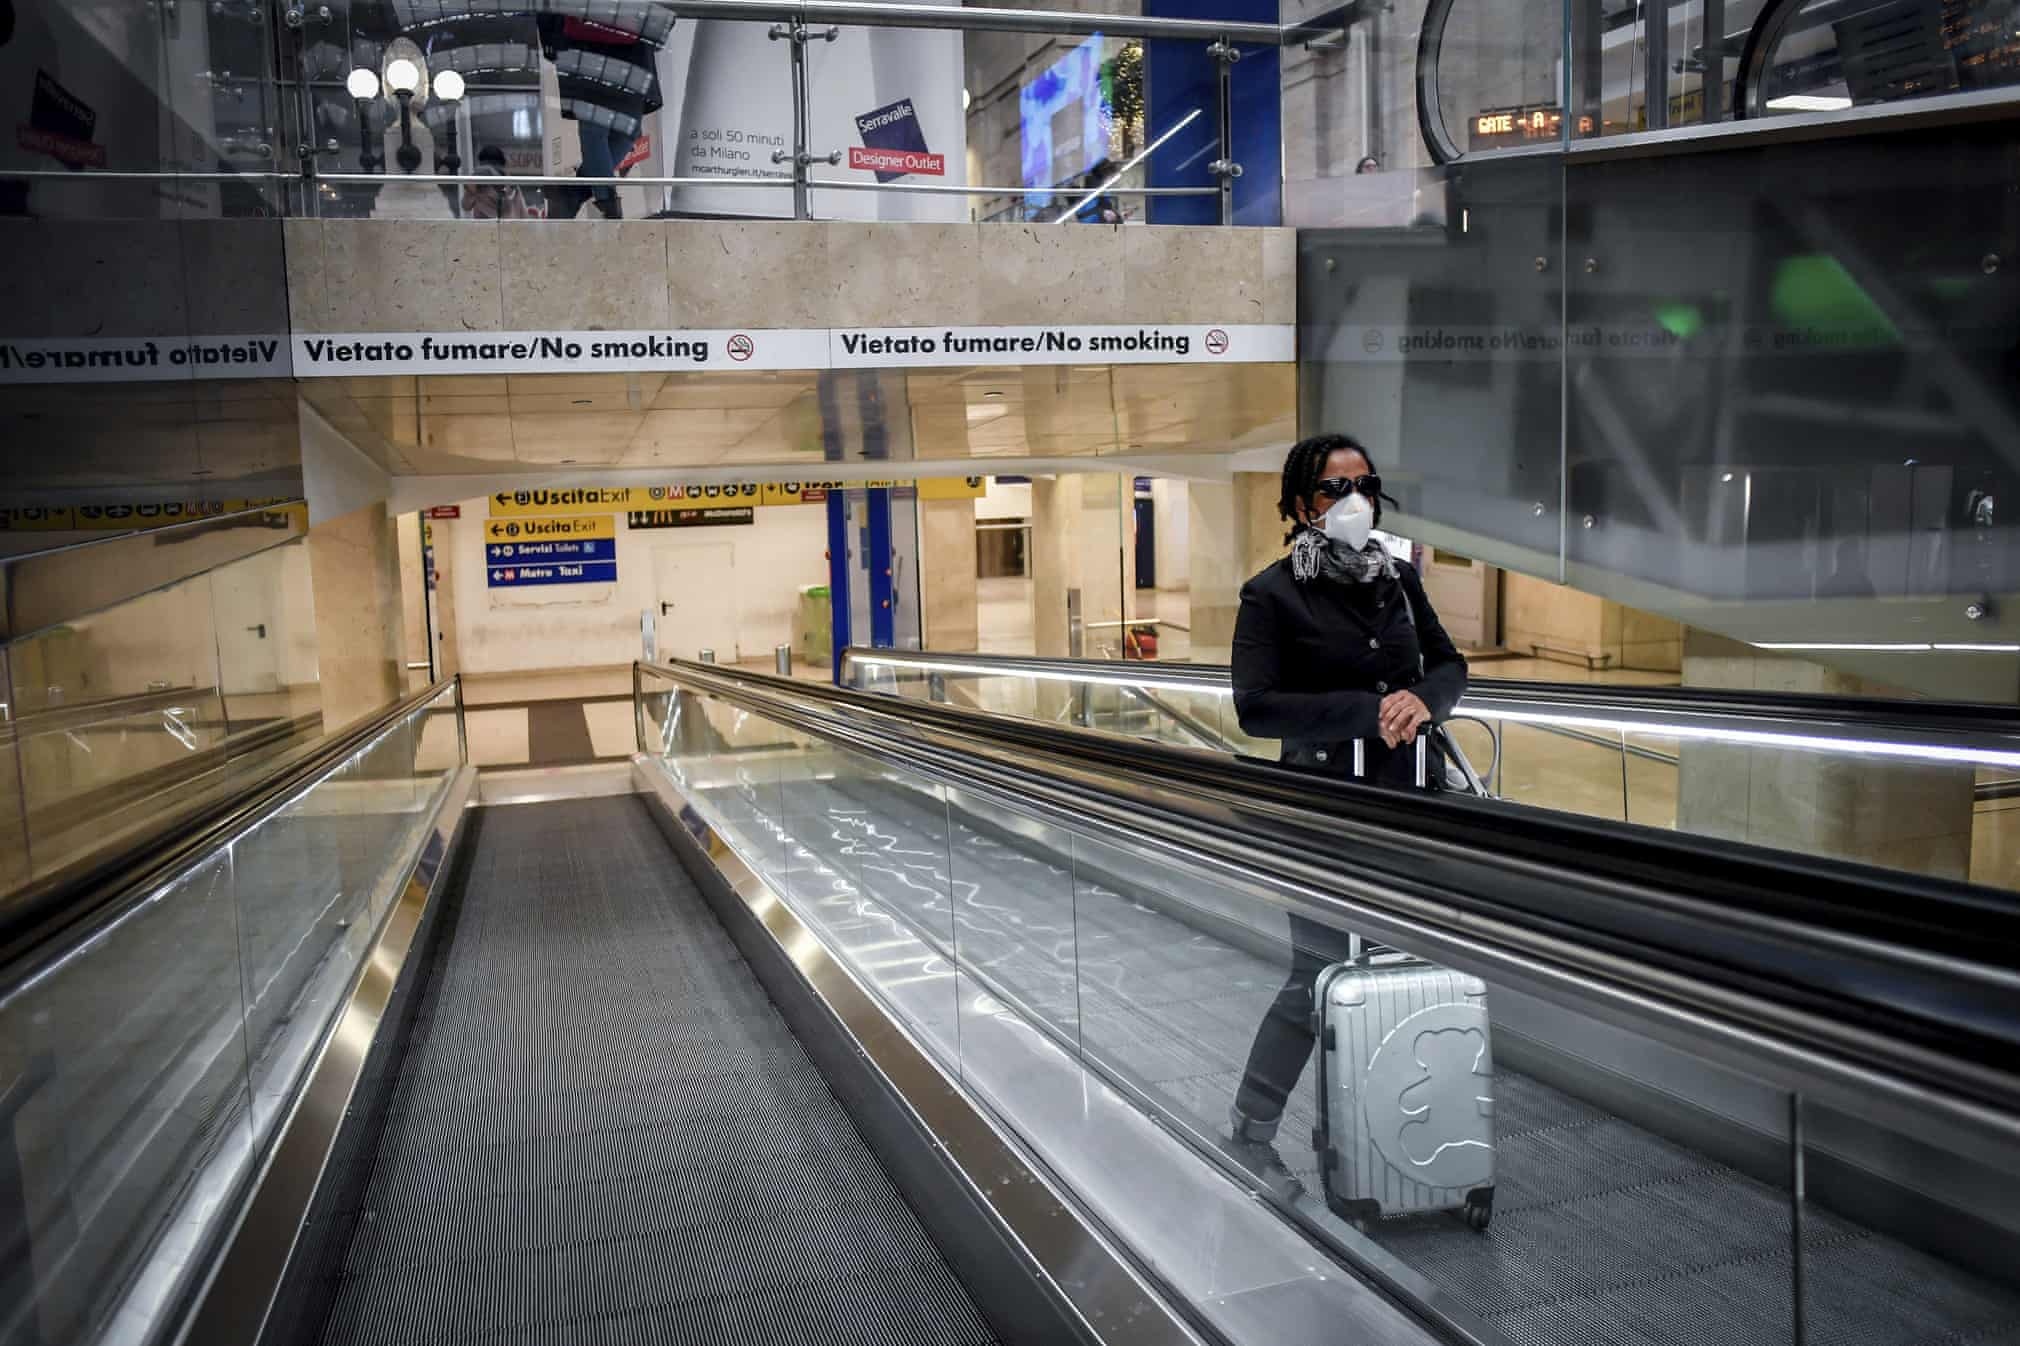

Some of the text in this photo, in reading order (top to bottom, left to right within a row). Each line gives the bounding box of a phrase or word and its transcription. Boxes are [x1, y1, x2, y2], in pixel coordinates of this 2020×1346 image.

[858, 103, 914, 134] Serravalle
[1478, 114, 1513, 134] GATE
[690, 129, 785, 146] a soli 50 minuti
[691, 145, 751, 161] da Milano
[853, 151, 942, 170] Designer Outlet
[304, 335, 709, 362] Vietato fumare/No smoking
[841, 329, 1190, 354] Vietato fumare/No smoking
[532, 489, 600, 505] Uscita
[600, 487, 632, 504] Exit
[524, 520, 597, 535] Uscita Exit
[559, 565, 583, 577] Taxi
